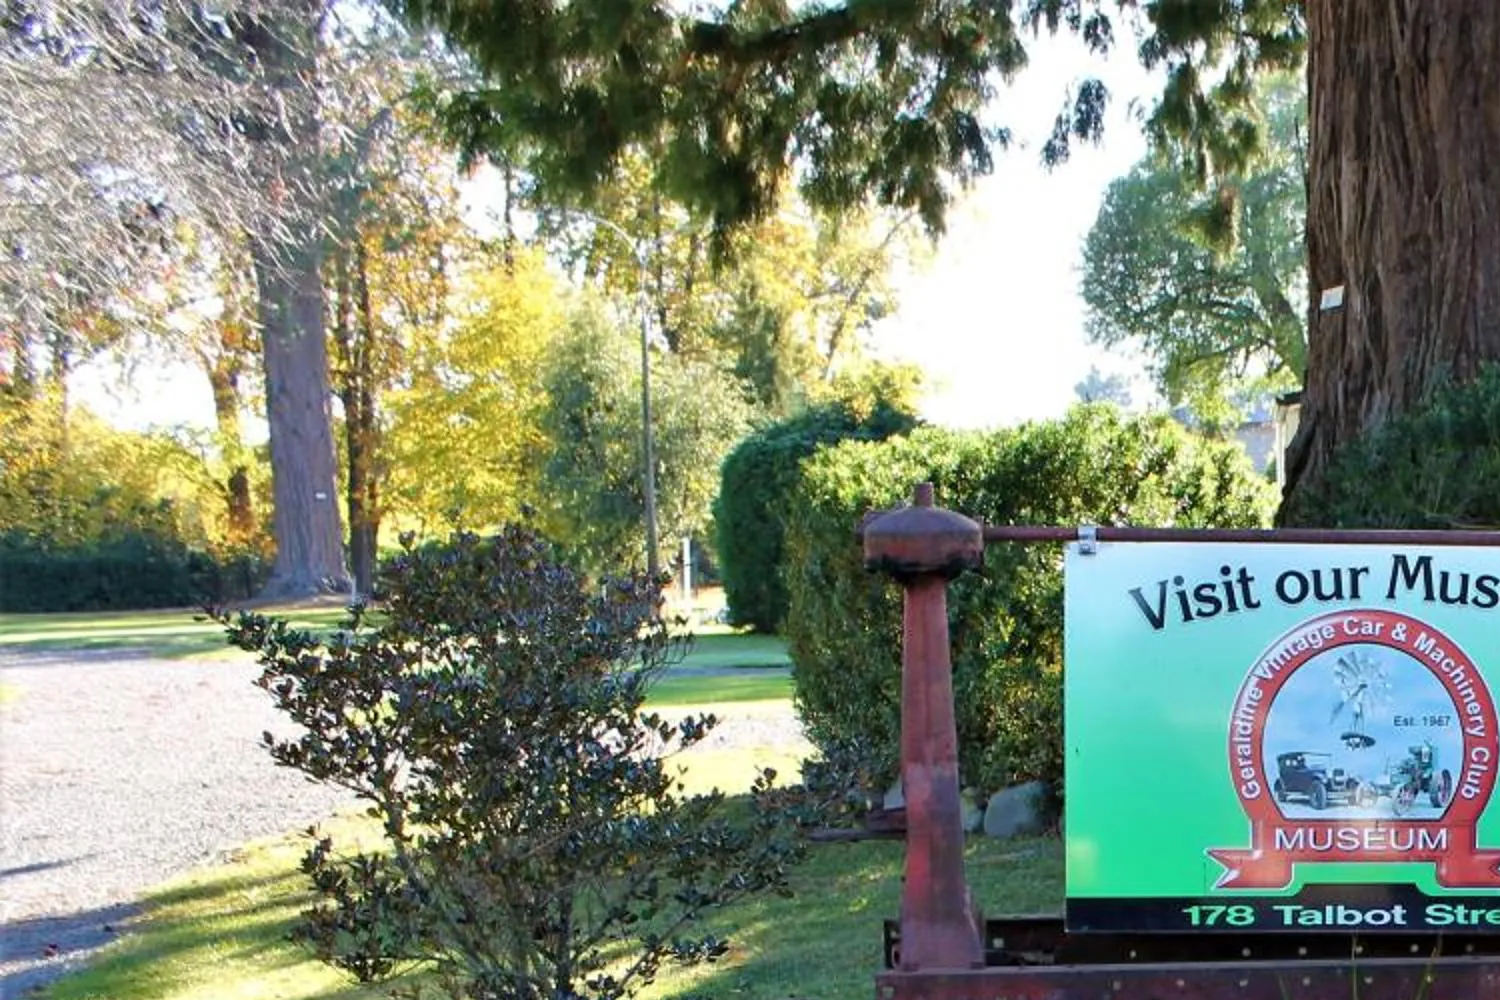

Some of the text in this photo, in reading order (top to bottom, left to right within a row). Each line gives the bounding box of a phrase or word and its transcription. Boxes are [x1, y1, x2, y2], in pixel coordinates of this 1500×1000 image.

[1129, 565, 1260, 632] Visit
[1275, 565, 1369, 604] our
[1232, 616, 1489, 799] Geraldine Vintage Car & Machinery Club
[1274, 828, 1448, 852] MUSEUM
[1182, 904, 1255, 926] 178
[1273, 904, 1407, 926] Talbot
